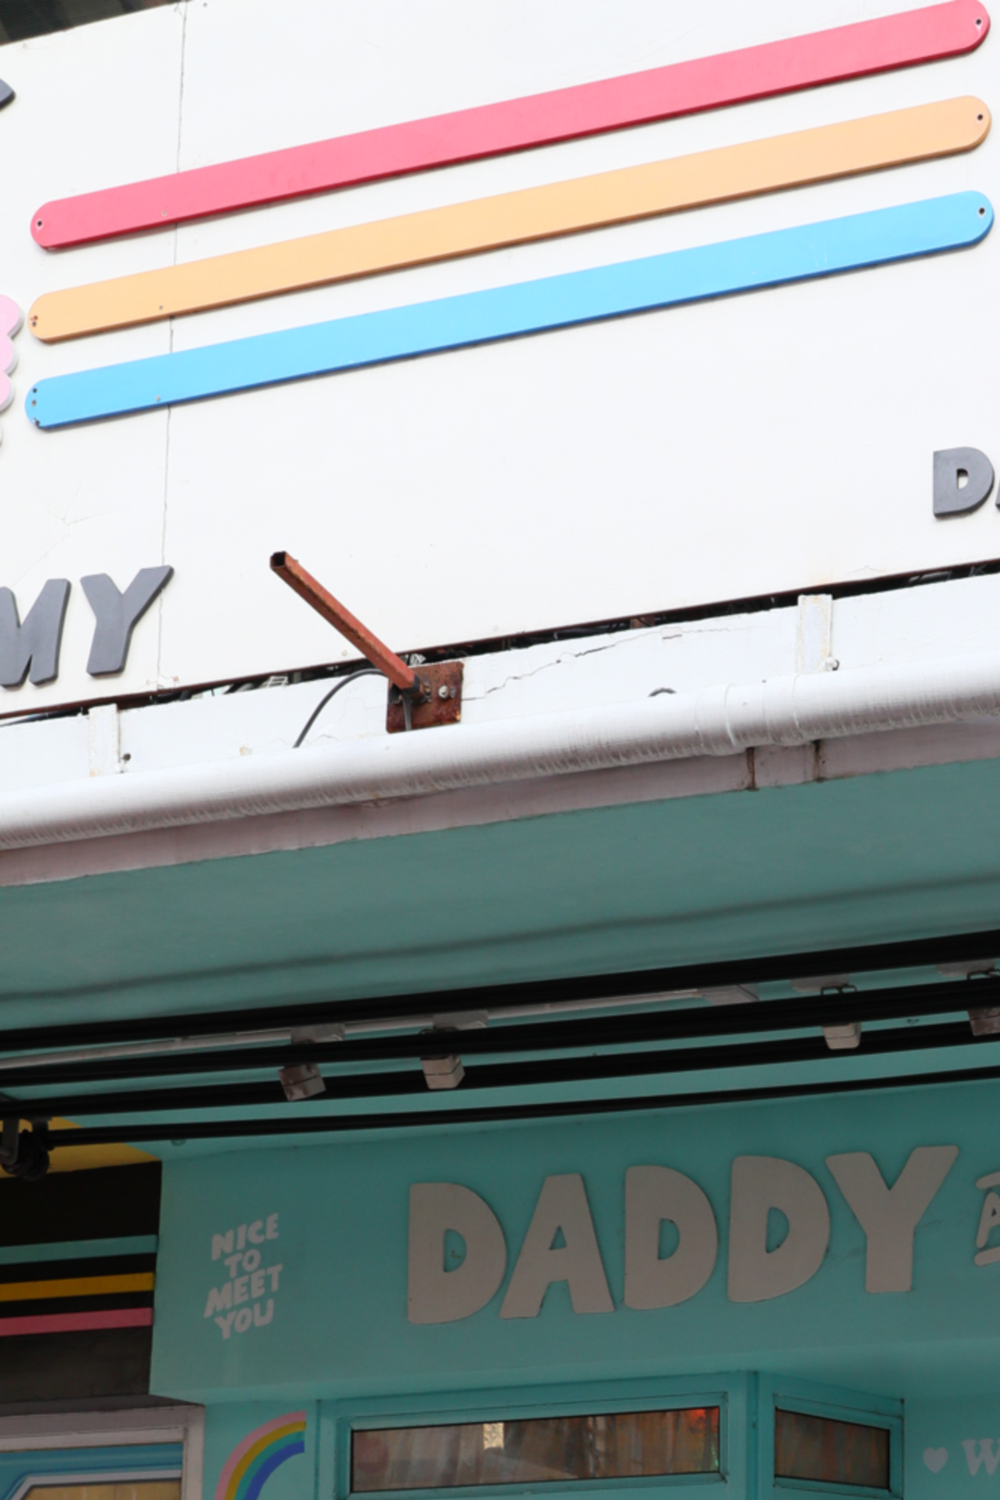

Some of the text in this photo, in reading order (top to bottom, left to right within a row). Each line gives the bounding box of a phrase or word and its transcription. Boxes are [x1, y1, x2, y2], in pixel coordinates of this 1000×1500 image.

[211, 1213, 279, 1261] NICE
[407, 1145, 960, 1326] DADDY
[224, 1249, 262, 1279] TO
[203, 1264, 283, 1319] MEET
[214, 1298, 275, 1341] YOU
